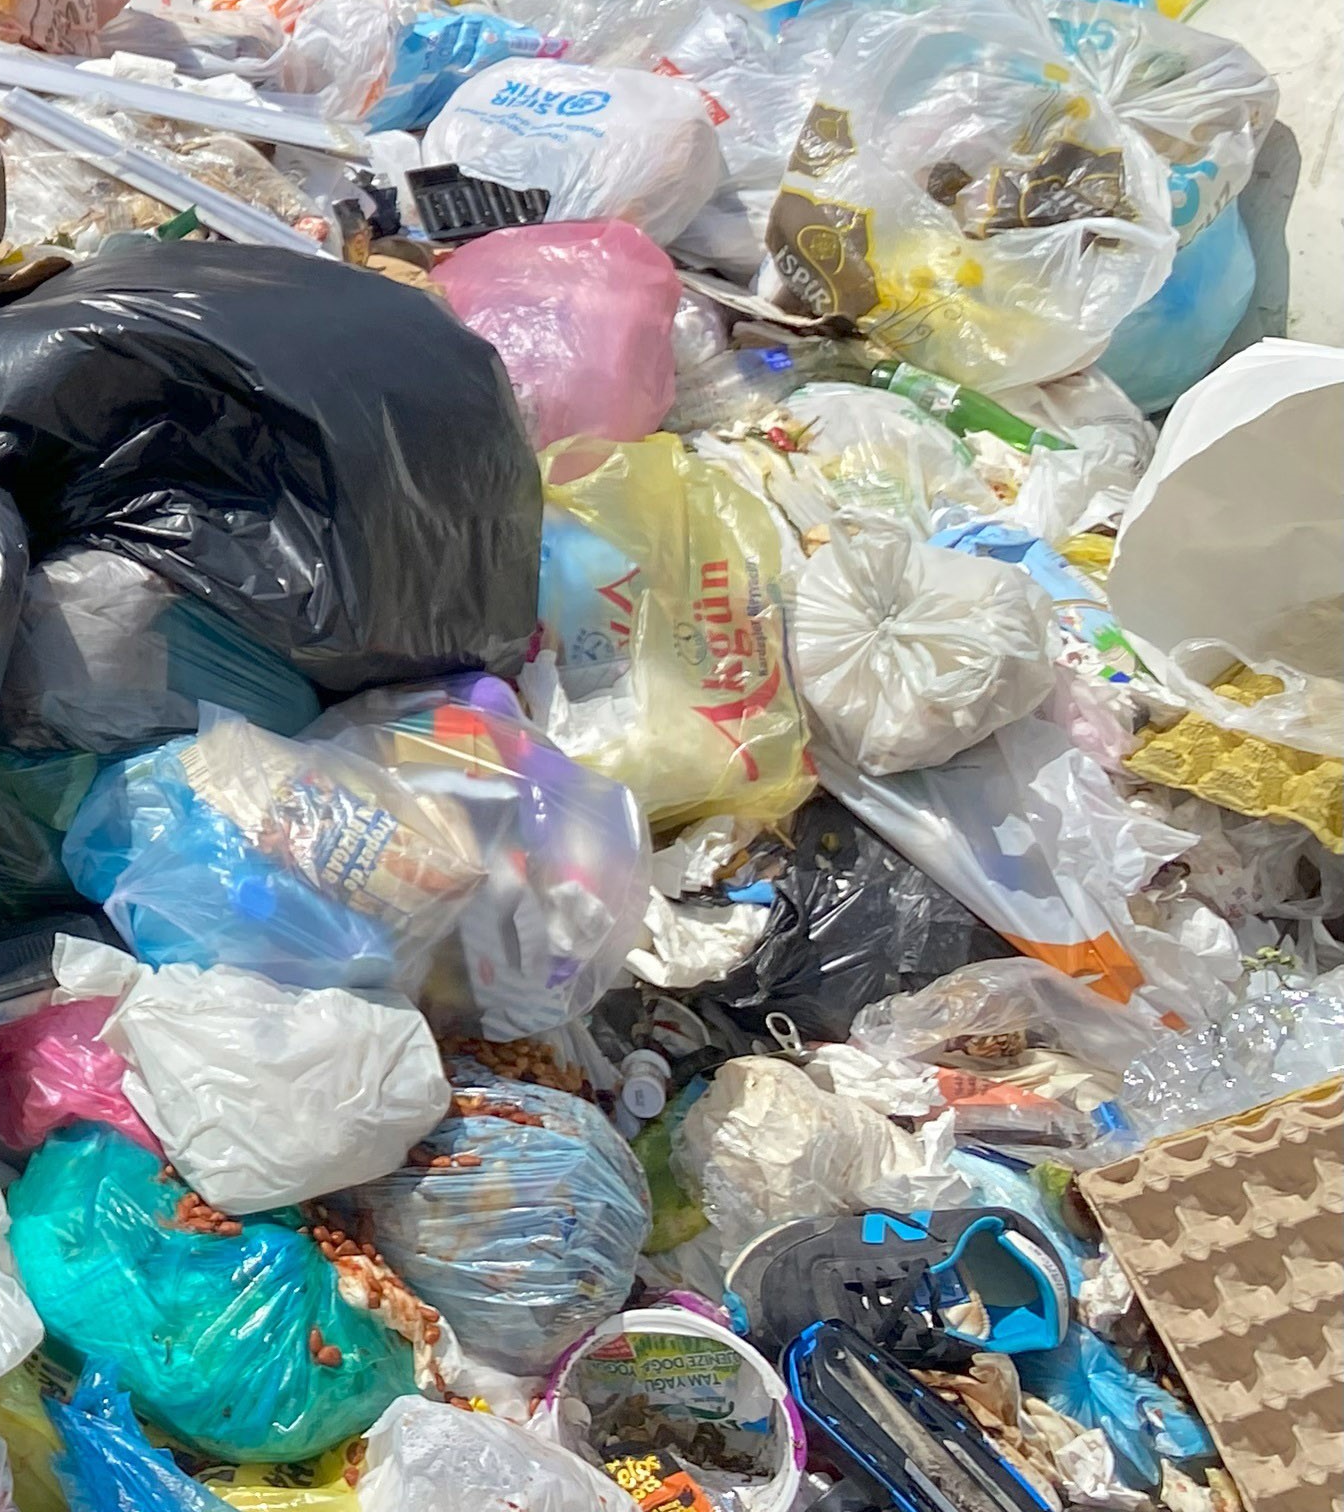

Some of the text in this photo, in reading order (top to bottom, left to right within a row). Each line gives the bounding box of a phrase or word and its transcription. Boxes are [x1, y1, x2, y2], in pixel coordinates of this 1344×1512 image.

[496, 80, 564, 102] ATIK
[490, 93, 554, 115] SIFIR
[690, 559, 781, 782] Akgün
[687, 1373, 722, 1388] TAM
